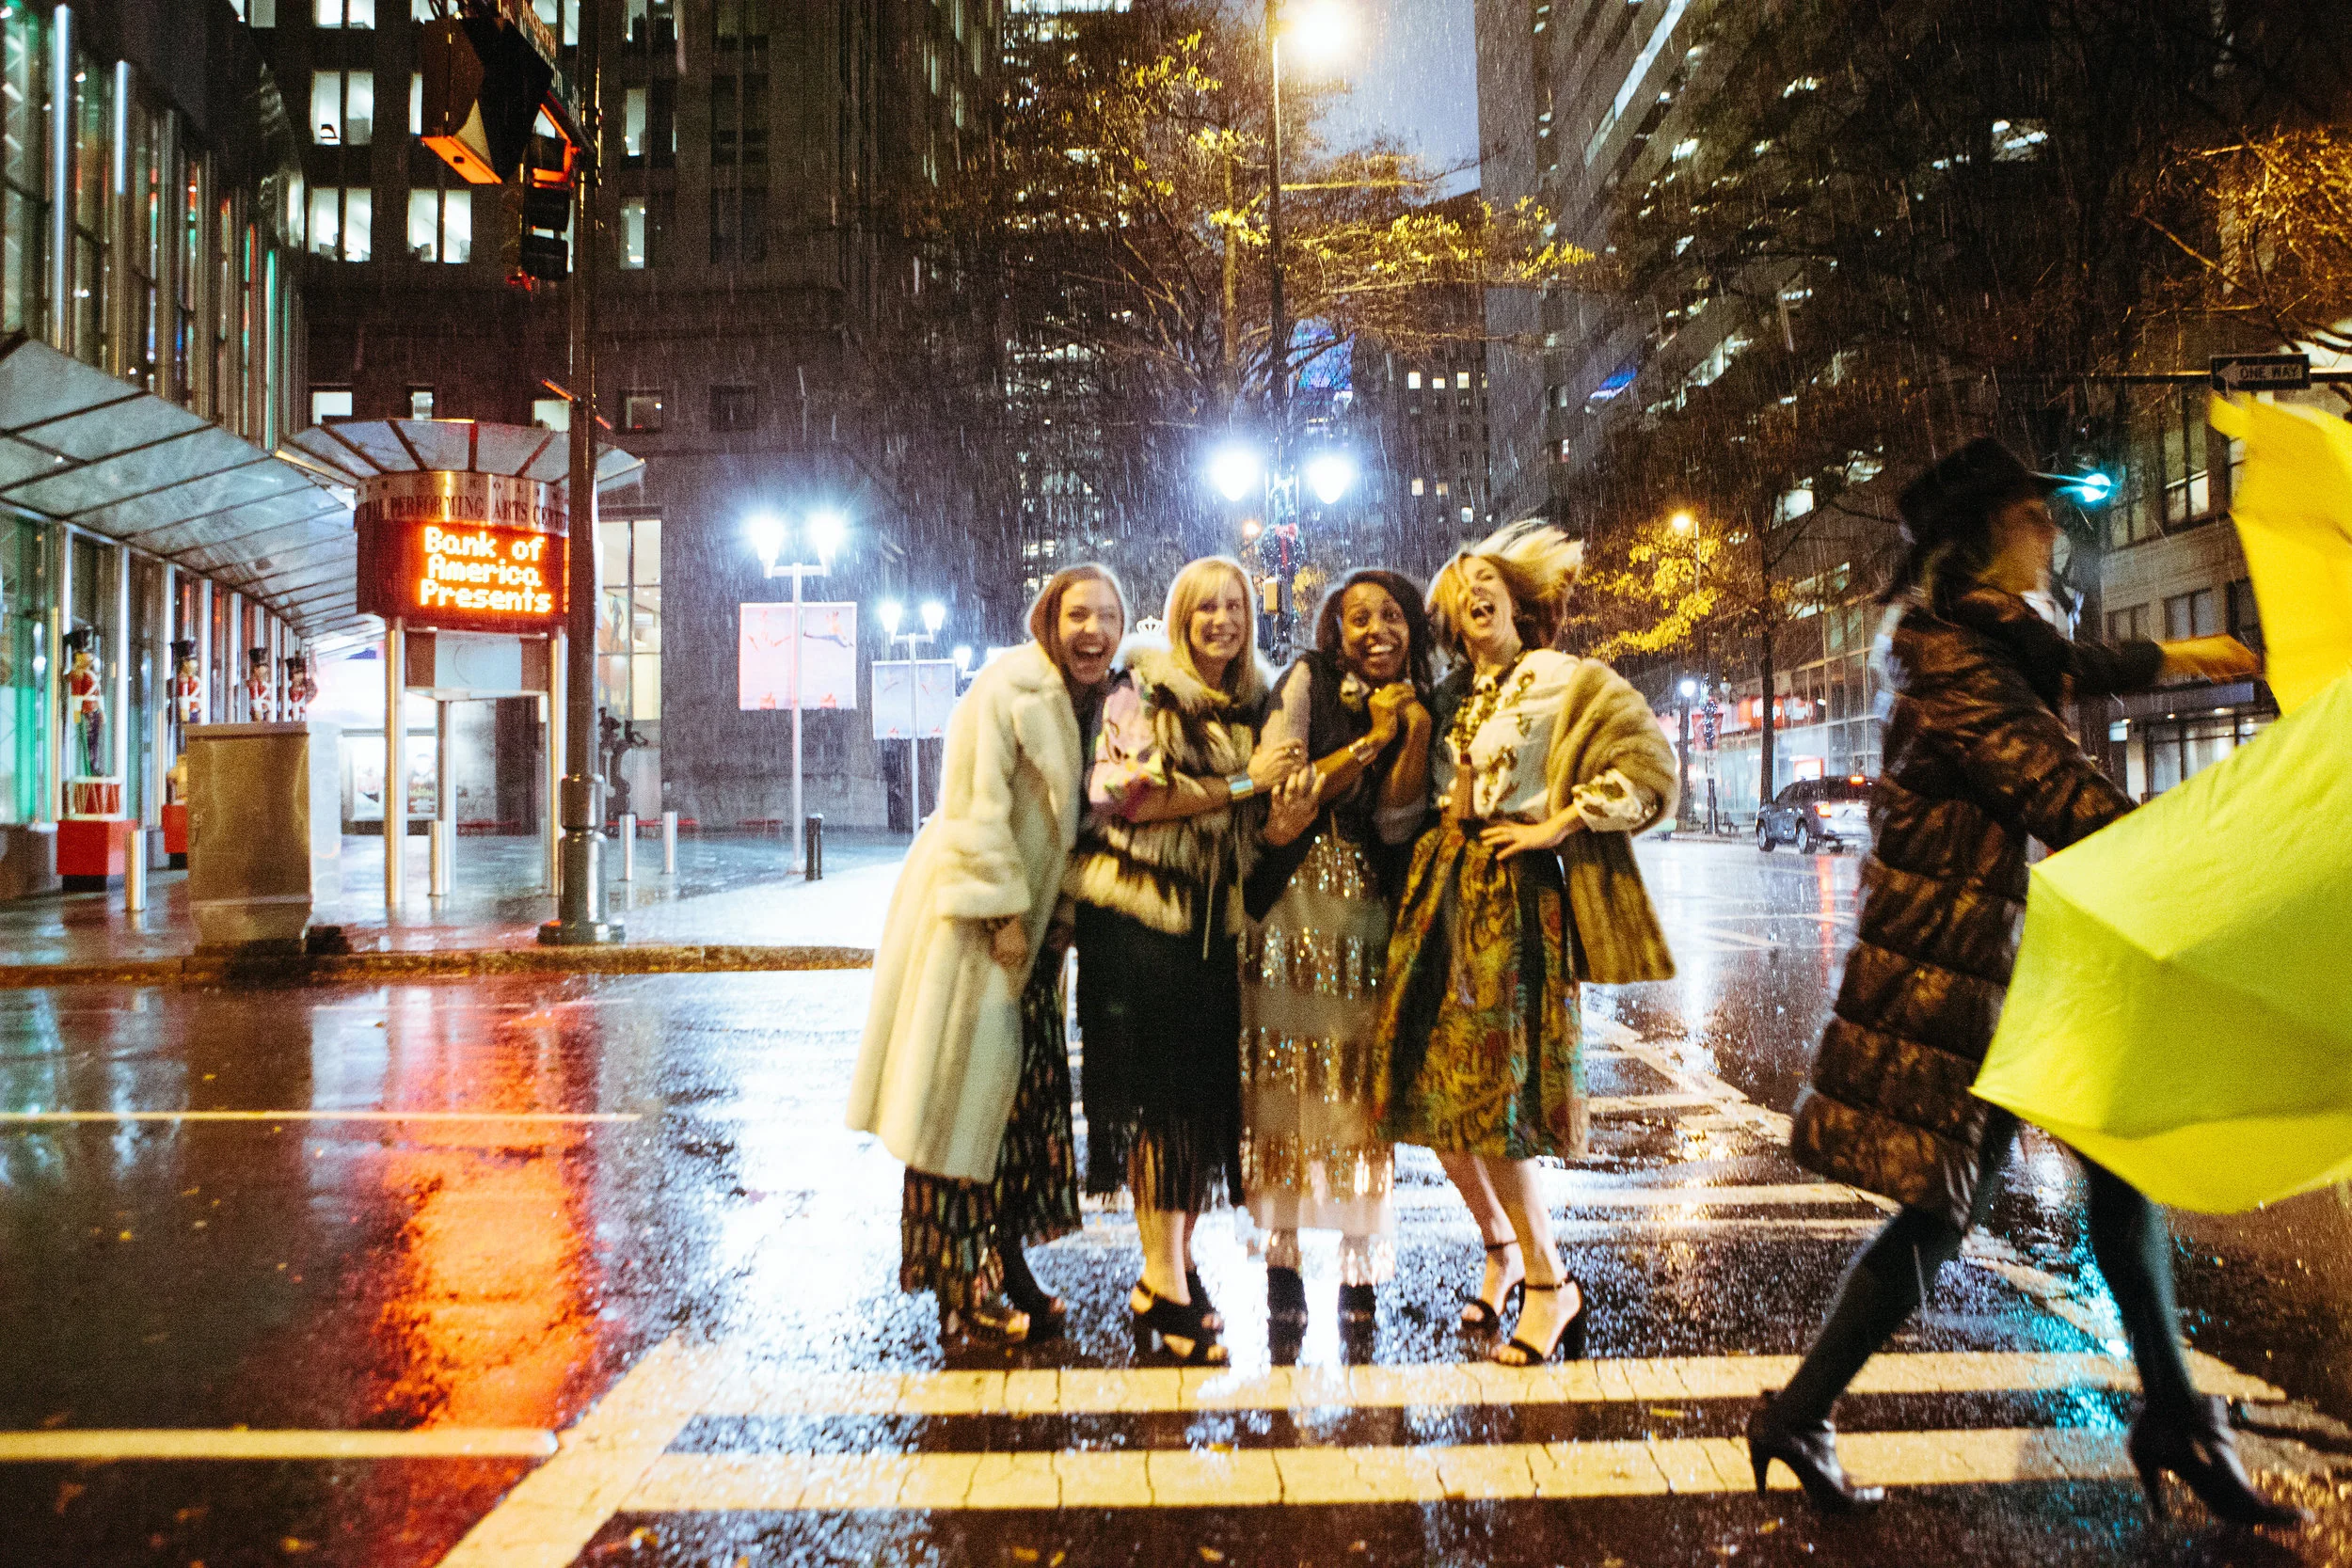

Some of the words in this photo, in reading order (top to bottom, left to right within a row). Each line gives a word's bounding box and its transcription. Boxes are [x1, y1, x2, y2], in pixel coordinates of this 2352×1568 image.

[524, 0, 556, 57] NORTH
[534, 34, 563, 99] Ton
[2240, 367, 2264, 379] ONE
[2272, 366, 2298, 378] WAY
[493, 499, 528, 523] ARTS
[424, 526, 497, 558] Bank
[512, 536, 545, 562] of
[428, 553, 542, 586] America
[420, 578, 551, 613] Presents
